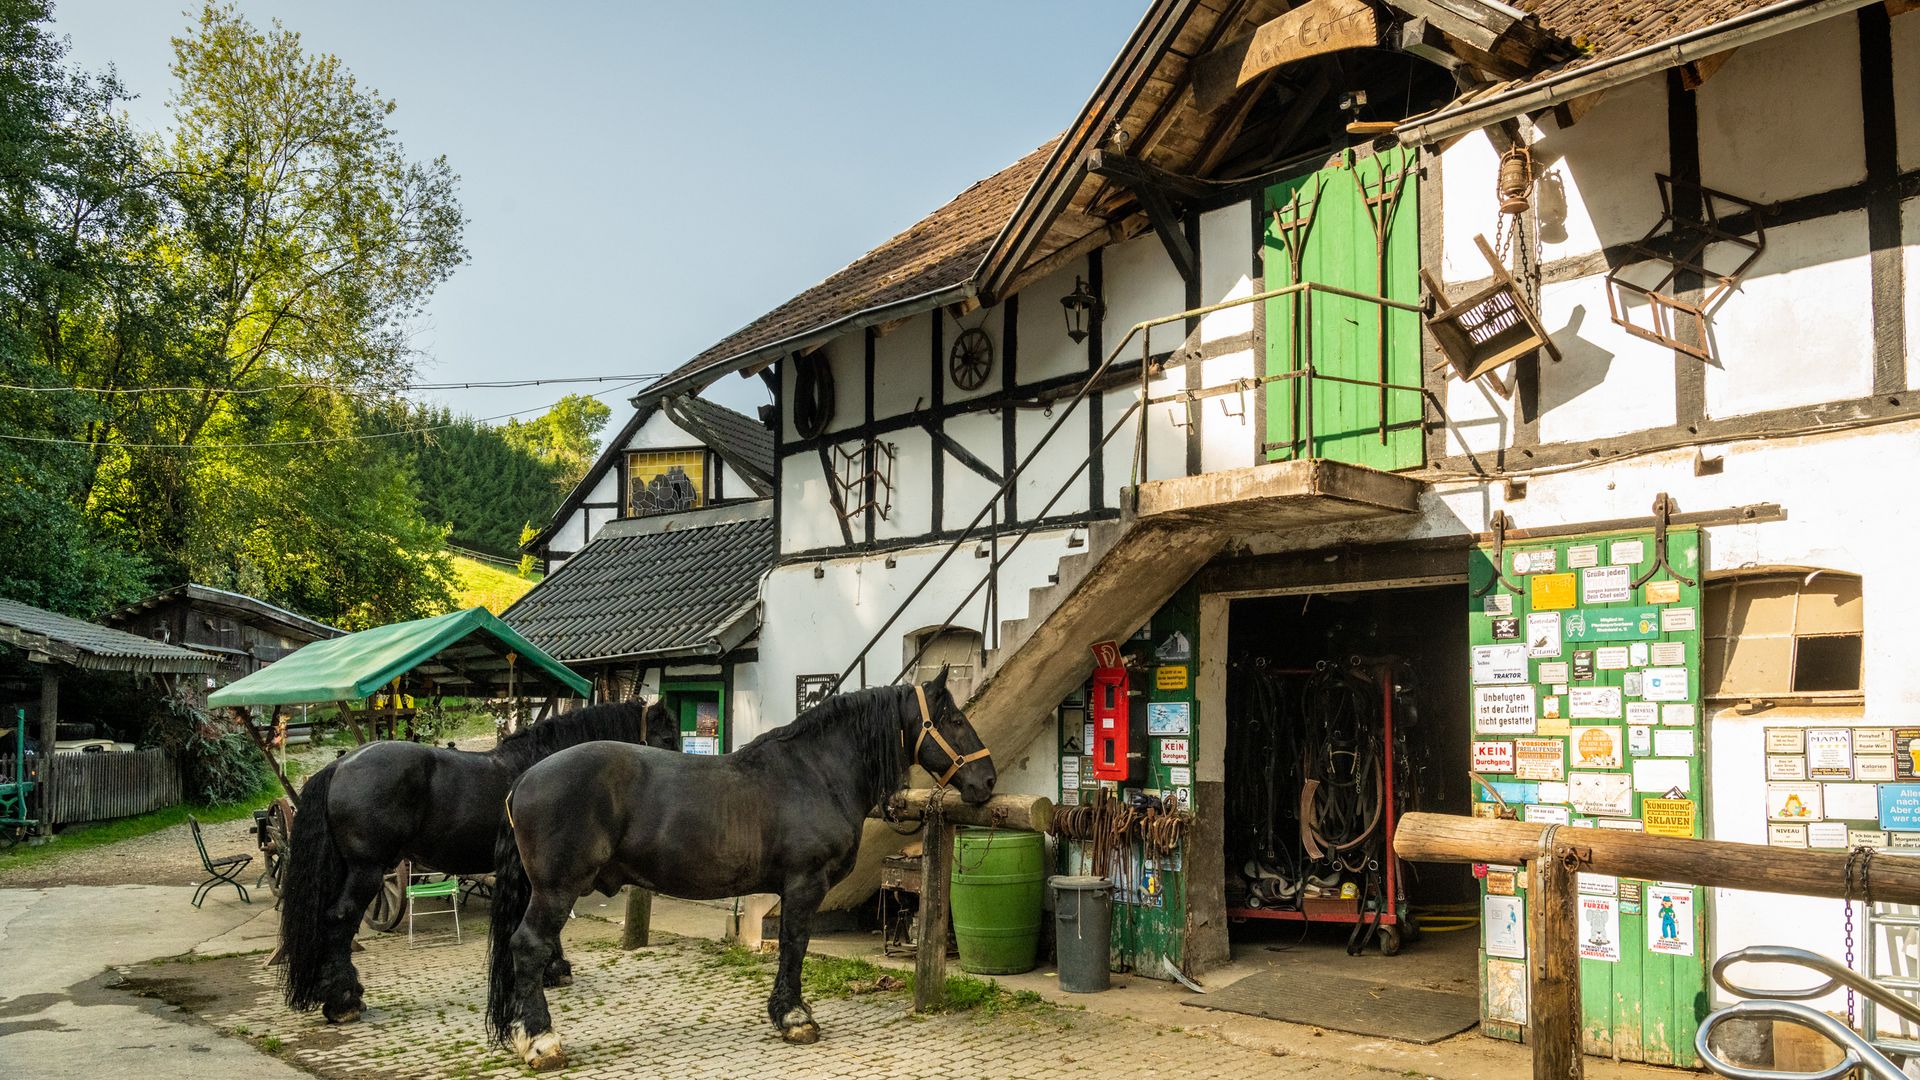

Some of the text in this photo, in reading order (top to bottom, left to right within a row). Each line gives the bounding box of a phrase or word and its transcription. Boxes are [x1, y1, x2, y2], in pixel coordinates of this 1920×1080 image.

[1606, 569, 1626, 577] jeden
[1483, 693, 1526, 703] Unbefugten
[1480, 704, 1529, 713] ist der Zutritt
[1478, 716, 1532, 728] nicht gestattet
[1165, 743, 1184, 751] KEIN
[1479, 747, 1506, 755] KEIN
[1890, 806, 1912, 814] Aber
[1648, 816, 1690, 825] SKLAVEN
[1580, 950, 1605, 958] SCHEISSE
